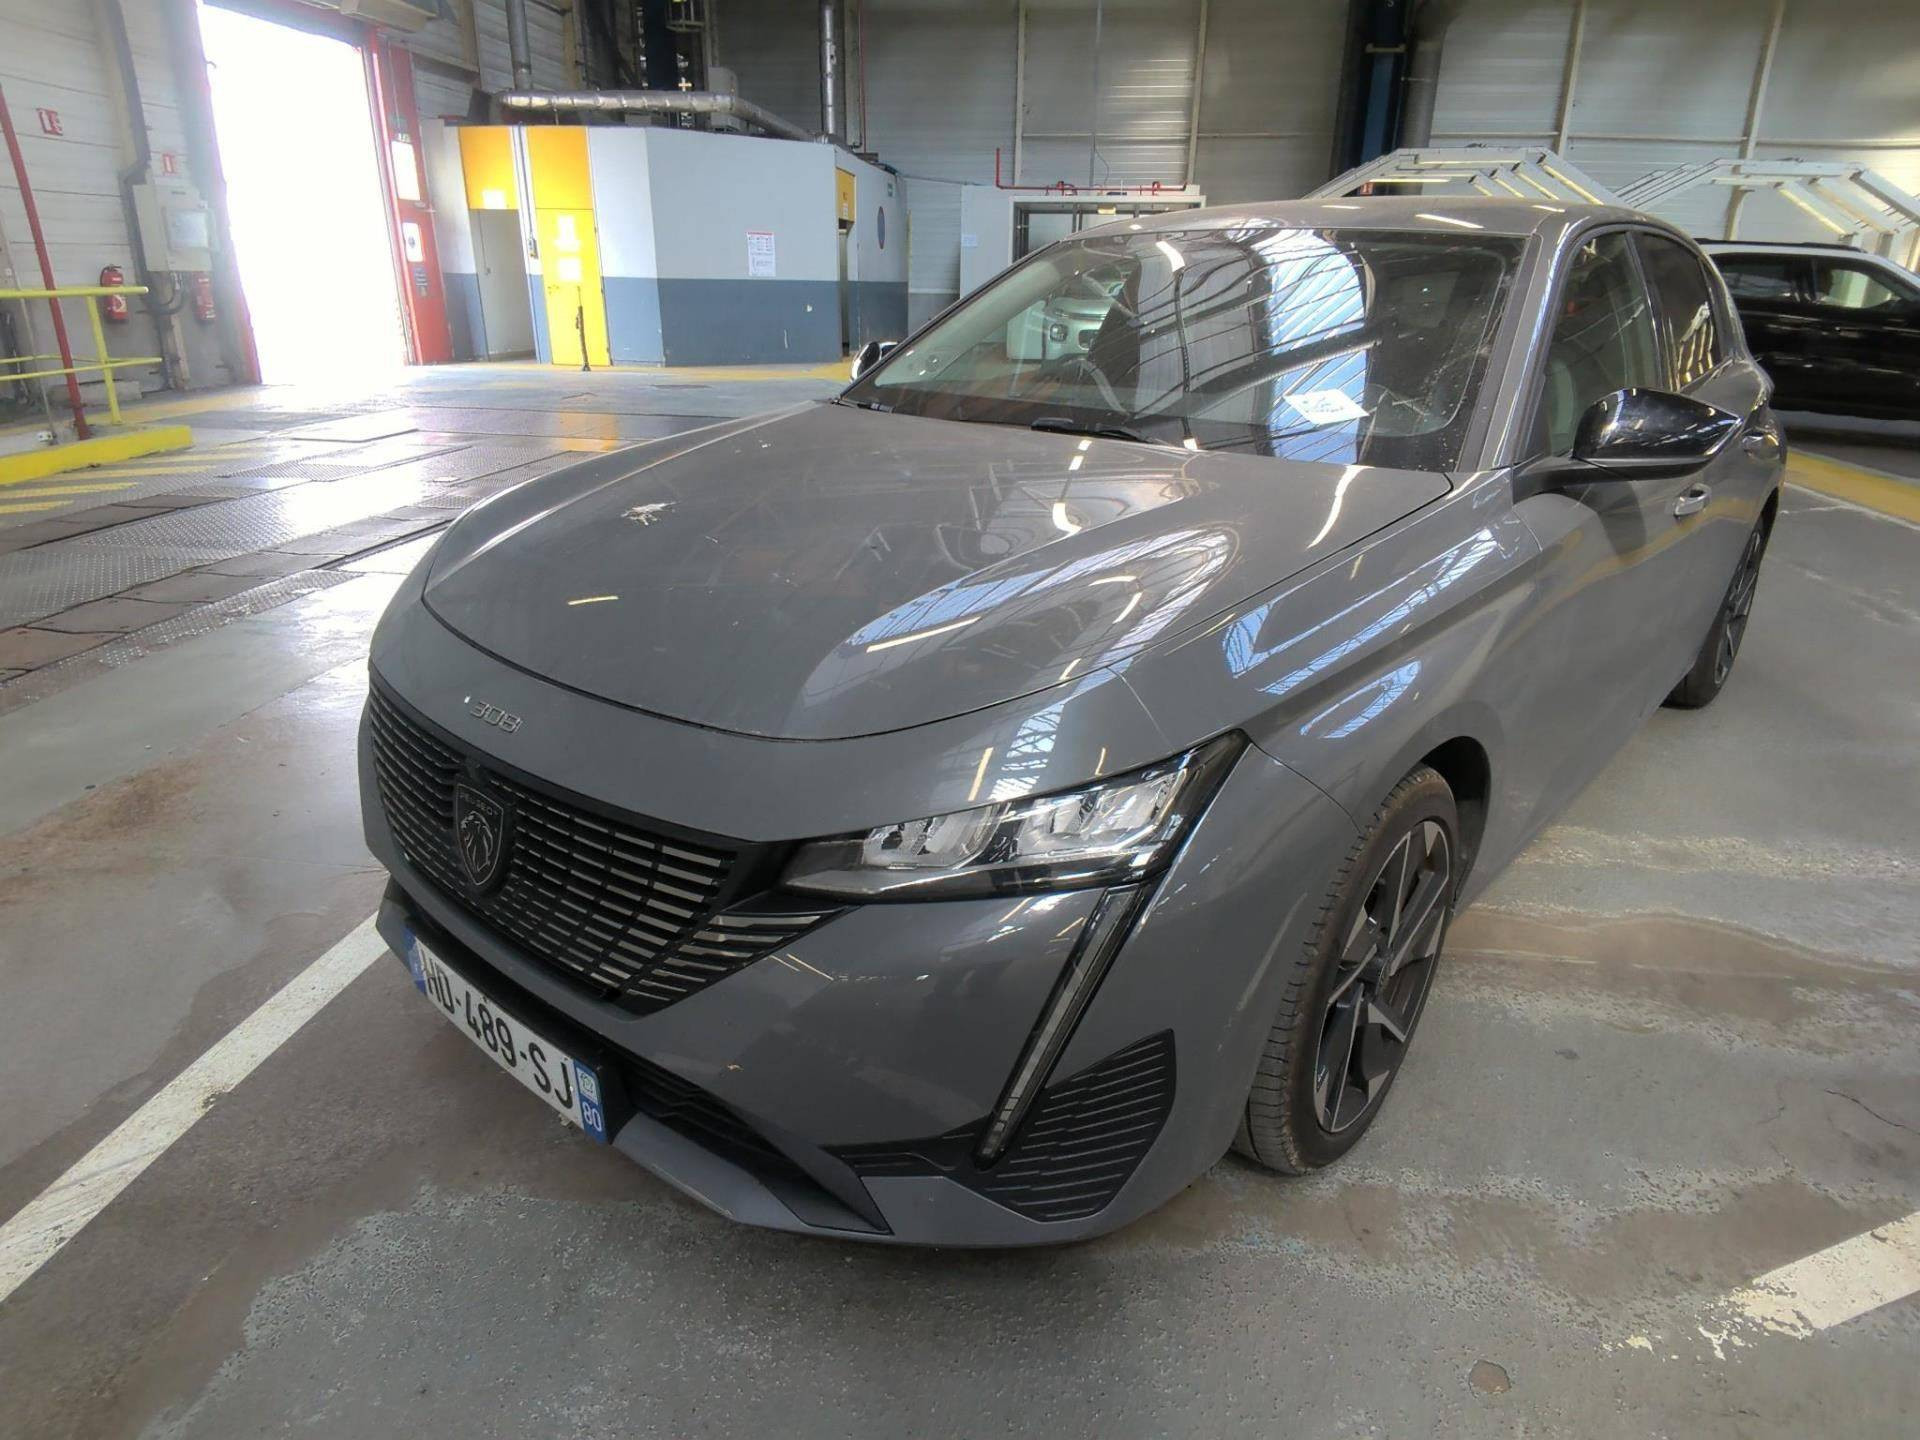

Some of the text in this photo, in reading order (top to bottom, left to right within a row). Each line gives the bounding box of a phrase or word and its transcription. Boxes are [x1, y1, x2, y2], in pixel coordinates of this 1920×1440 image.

[470, 701, 522, 733] 308
[420, 948, 602, 1132] HD-489-SJ 80
